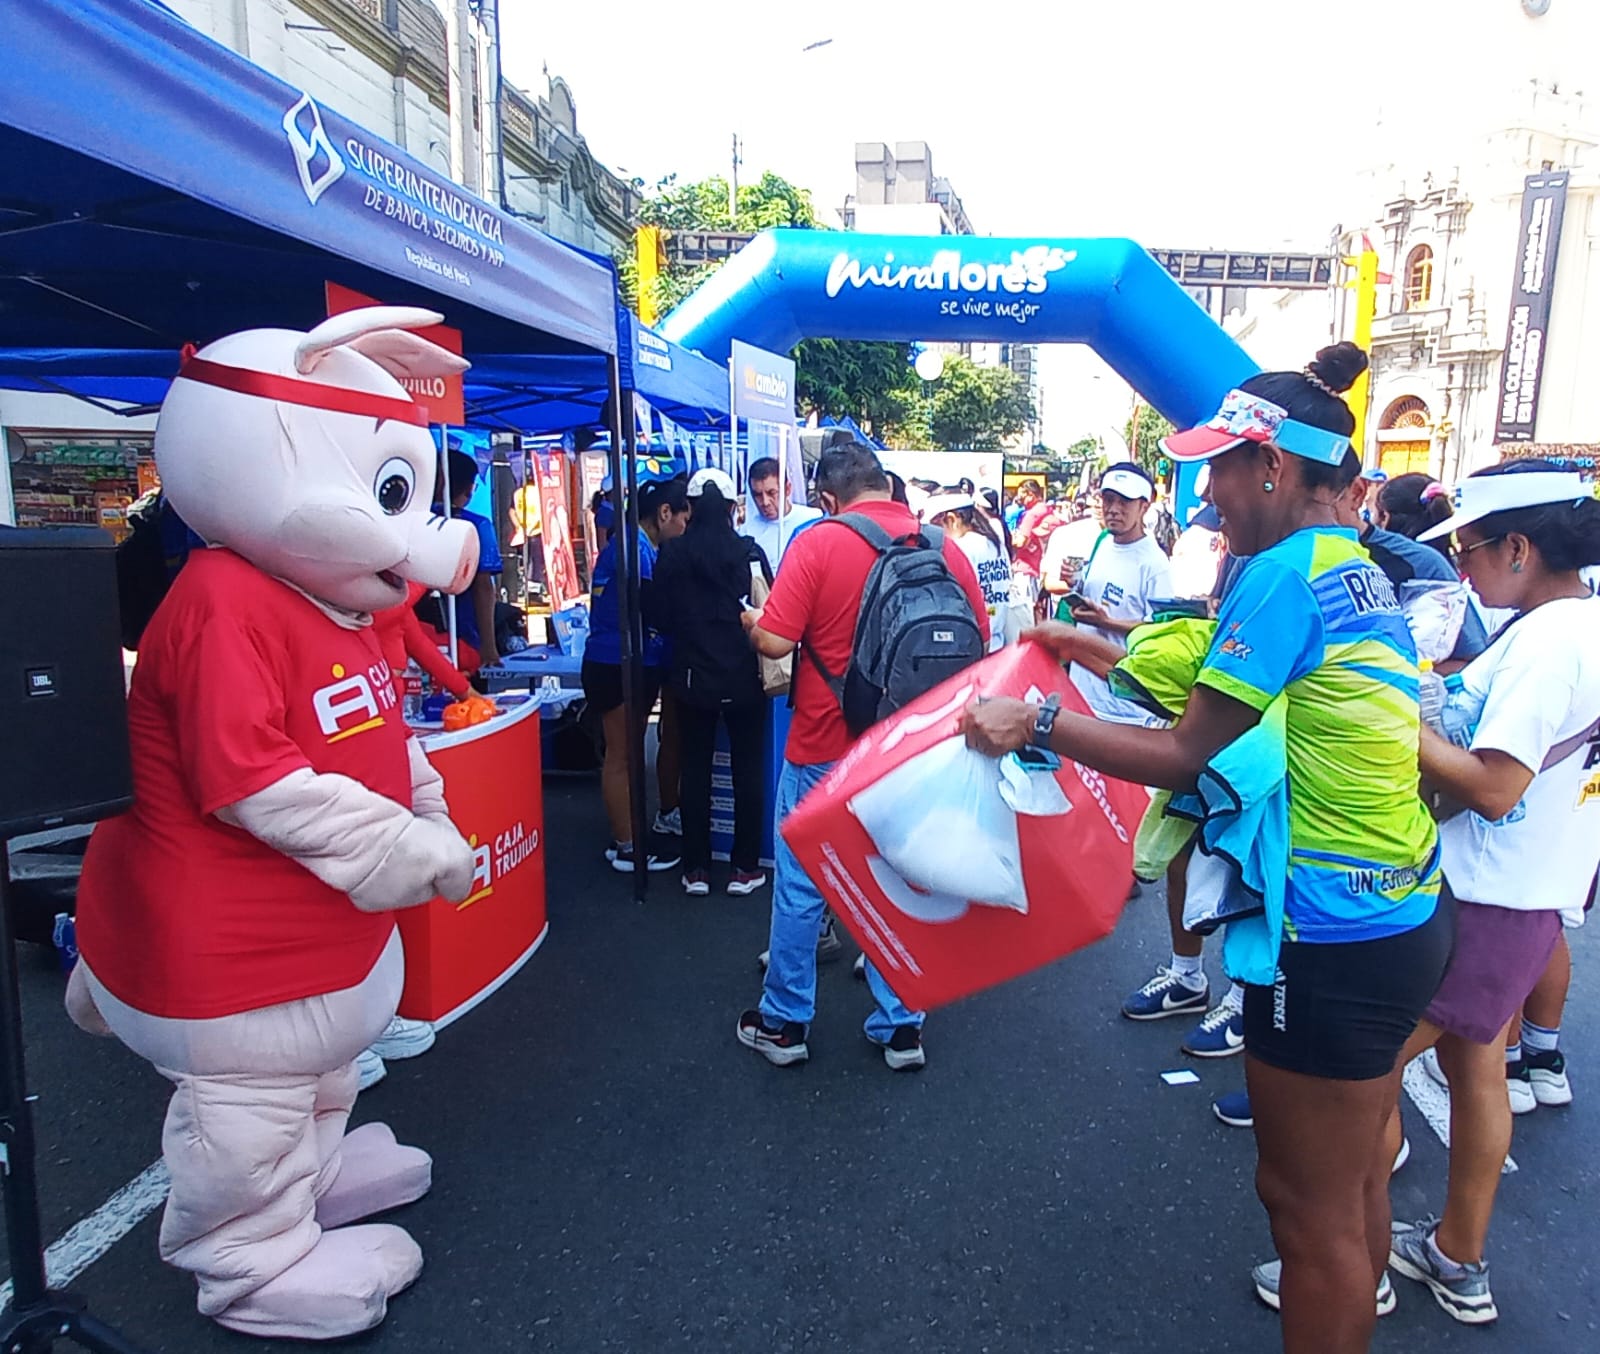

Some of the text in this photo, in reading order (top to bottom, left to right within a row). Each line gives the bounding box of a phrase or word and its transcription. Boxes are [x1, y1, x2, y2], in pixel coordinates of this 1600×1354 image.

[346, 139, 504, 245] SUPERINTENDENCIA
[364, 185, 384, 212] DE
[385, 193, 430, 237] BANCA,
[433, 220, 479, 257] SEGUROS
[479, 243, 487, 261] Y
[940, 298, 1040, 324] se vive mejor
[495, 821, 524, 856] CAJA
[495, 829, 539, 879] TRUJILLO
[1347, 869, 1374, 895] UN
[1273, 984, 1286, 1032] TERREX
